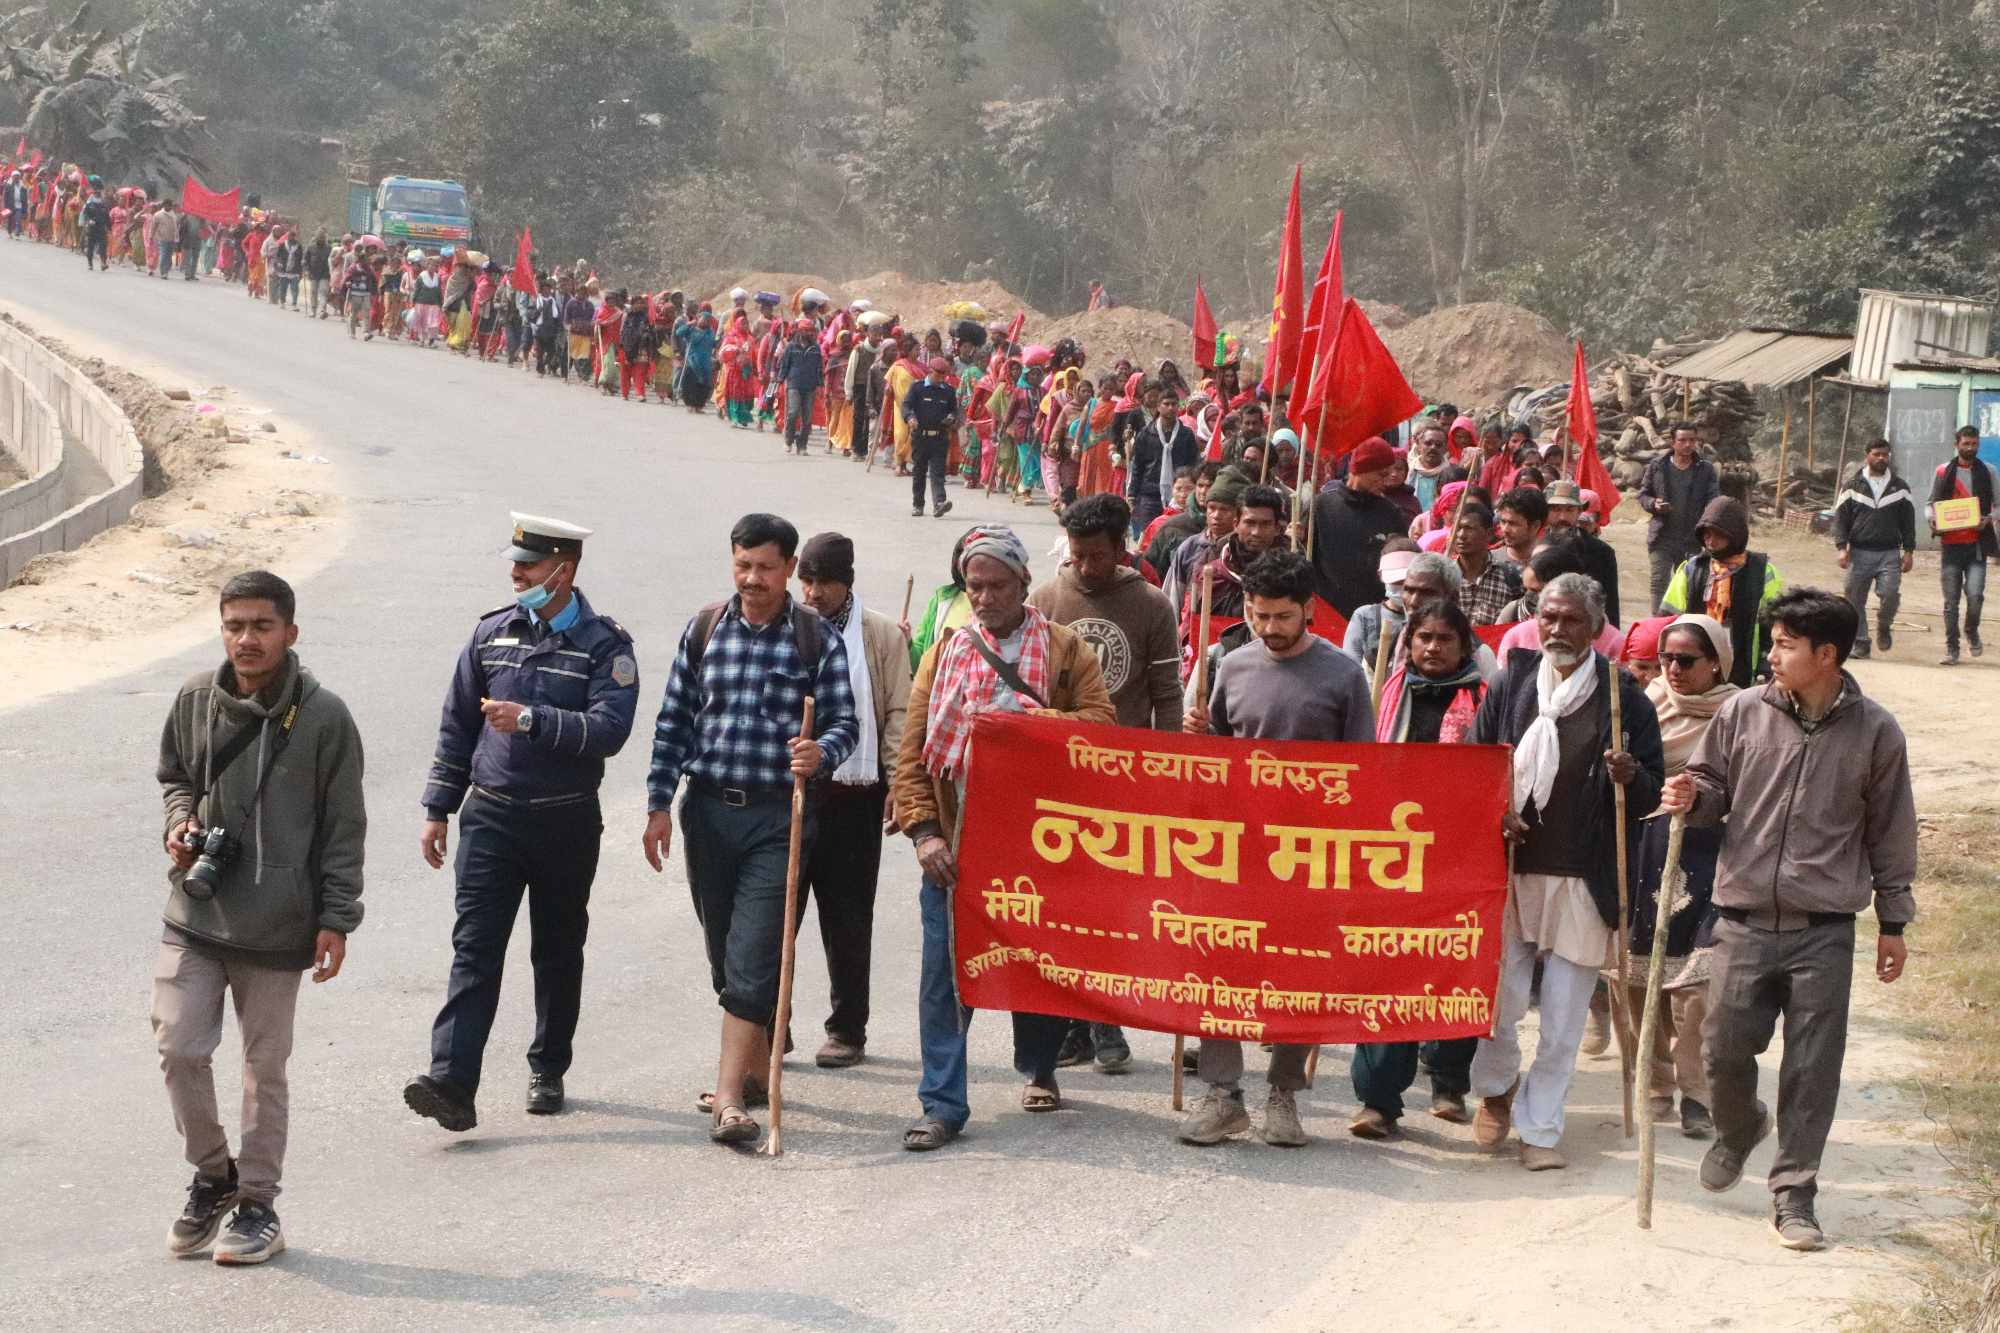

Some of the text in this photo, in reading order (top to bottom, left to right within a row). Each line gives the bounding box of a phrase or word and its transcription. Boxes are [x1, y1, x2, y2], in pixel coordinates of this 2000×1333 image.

[1066, 736, 1135, 782] मिटर
[1142, 751, 1231, 785] ब्याज
[1031, 798, 1434, 892] न्याय मार्च
[1037, 953, 1084, 990] मिटर
[1085, 971, 1133, 998] ब्याज
[1132, 976, 1171, 1006] तथा
[1170, 972, 1211, 1007] ठगी
[1439, 986, 1490, 1025] समिति
[1198, 1010, 1266, 1041] नेपाल
